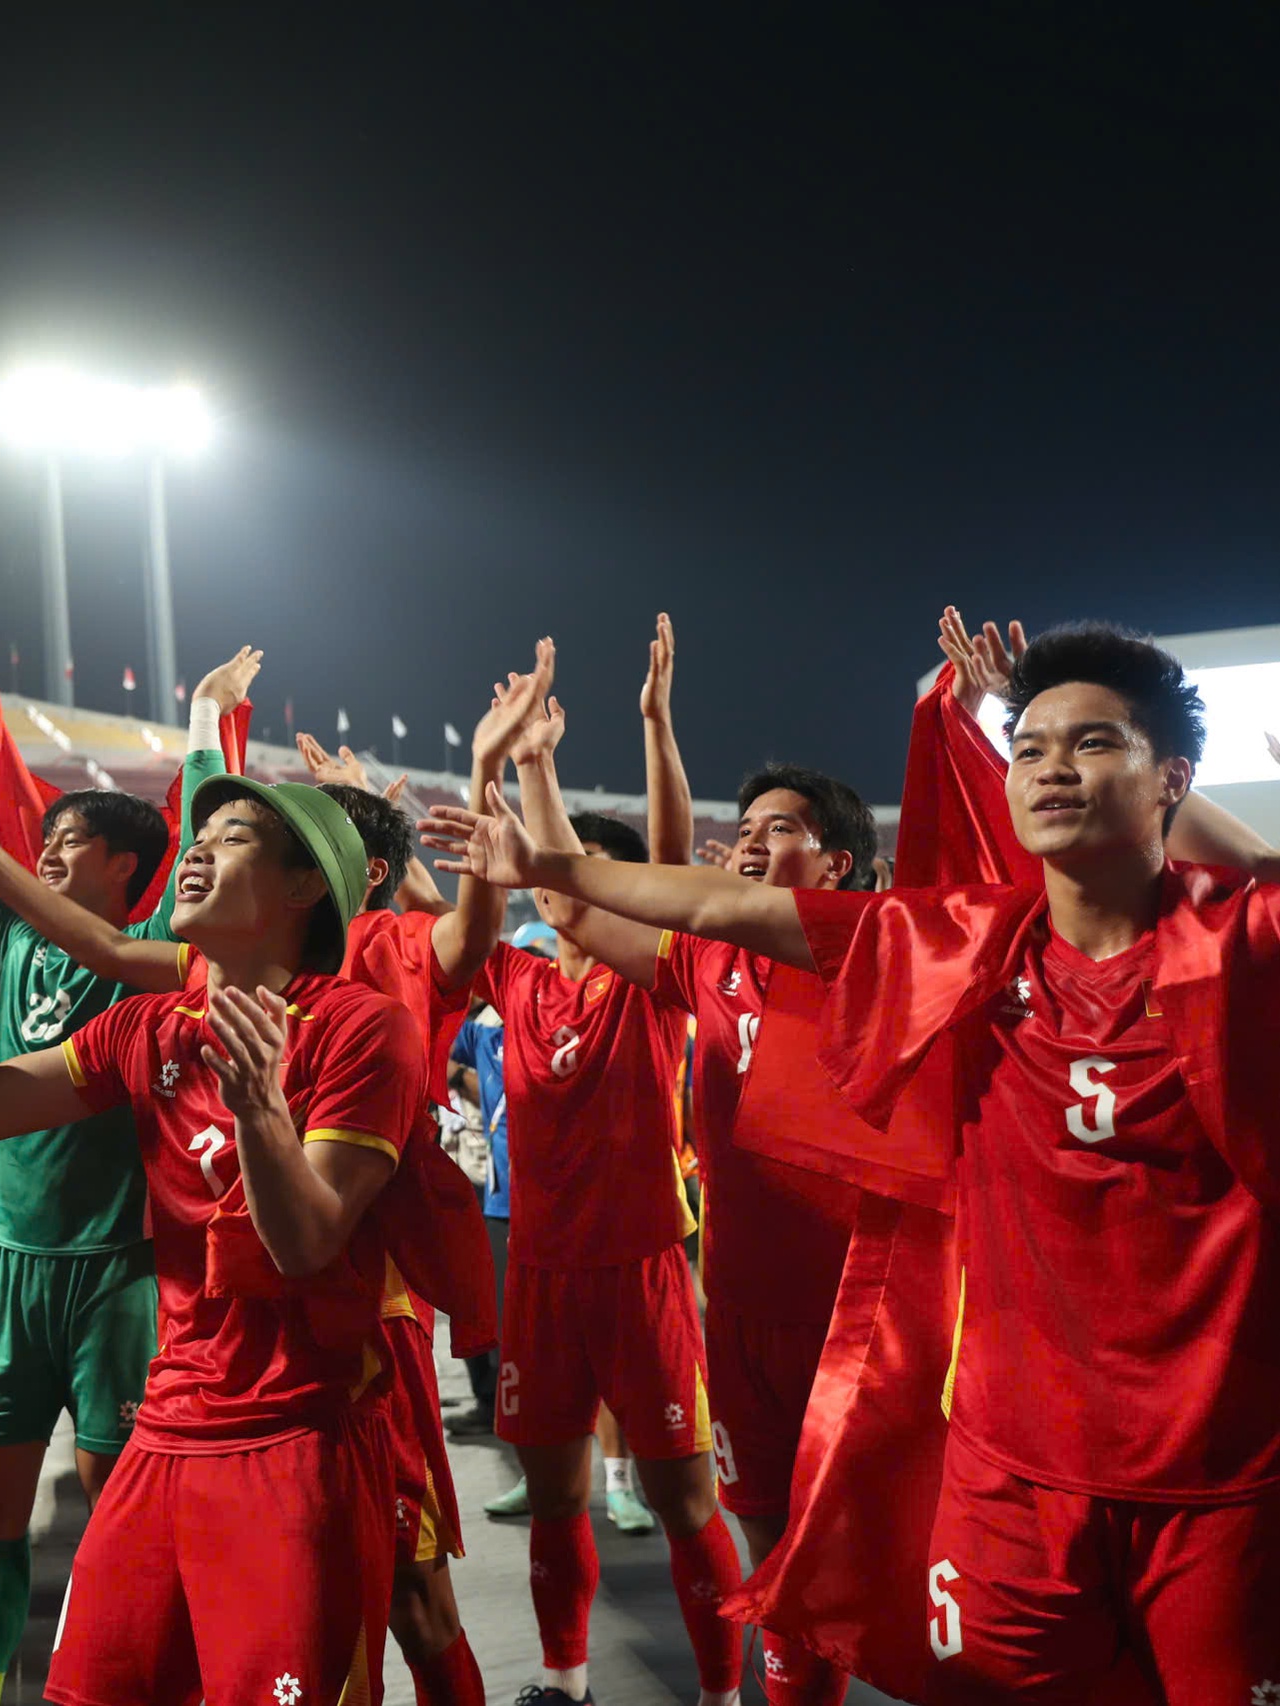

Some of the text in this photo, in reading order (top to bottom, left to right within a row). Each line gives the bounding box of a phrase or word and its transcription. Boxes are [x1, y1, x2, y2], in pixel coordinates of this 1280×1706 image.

[551, 1025, 580, 1077] 2
[1065, 1055, 1117, 1143] 5
[928, 1558, 963, 1662] 5
